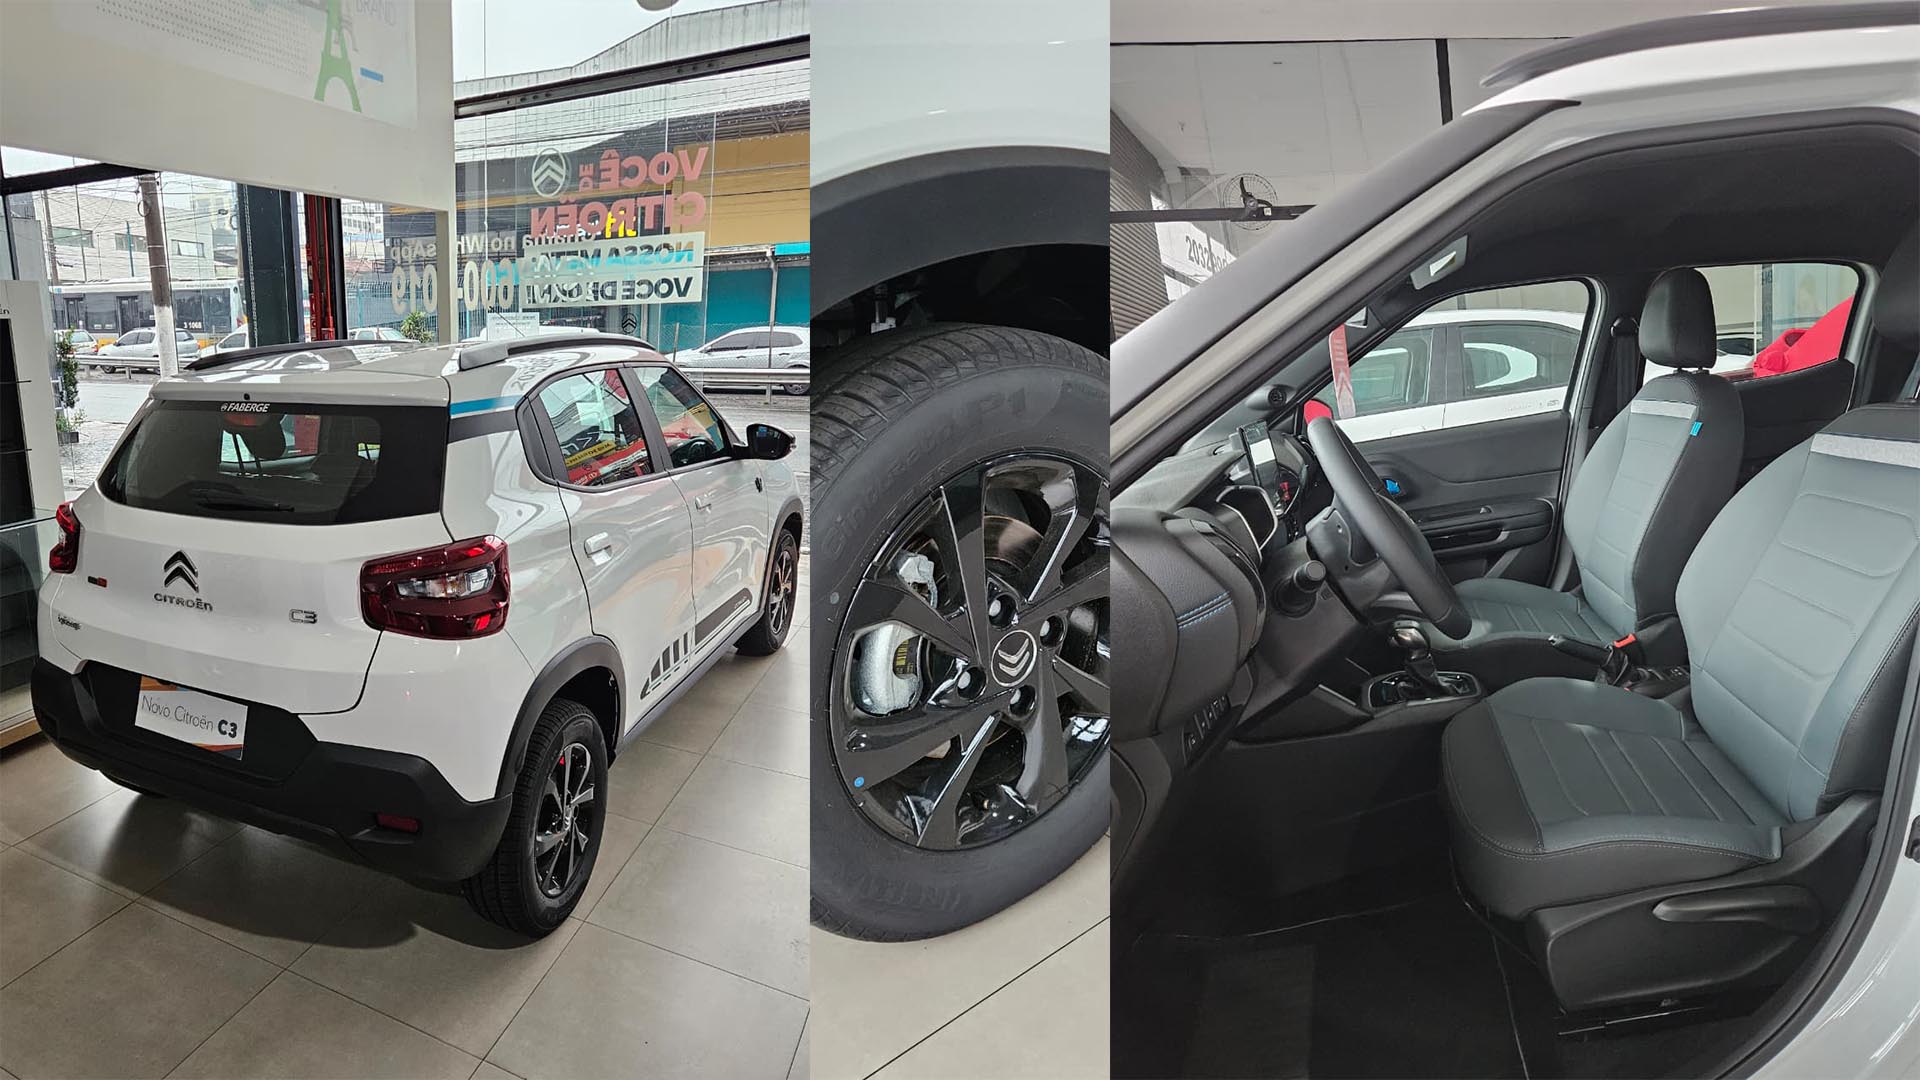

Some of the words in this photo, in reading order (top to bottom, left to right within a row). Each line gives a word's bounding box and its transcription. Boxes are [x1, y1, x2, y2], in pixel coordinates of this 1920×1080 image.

[227, 402, 271, 413] FABERGE
[289, 608, 318, 625] C3
[141, 695, 171, 718] Novo
[174, 705, 214, 731] Citroën
[217, 719, 238, 739] C3
